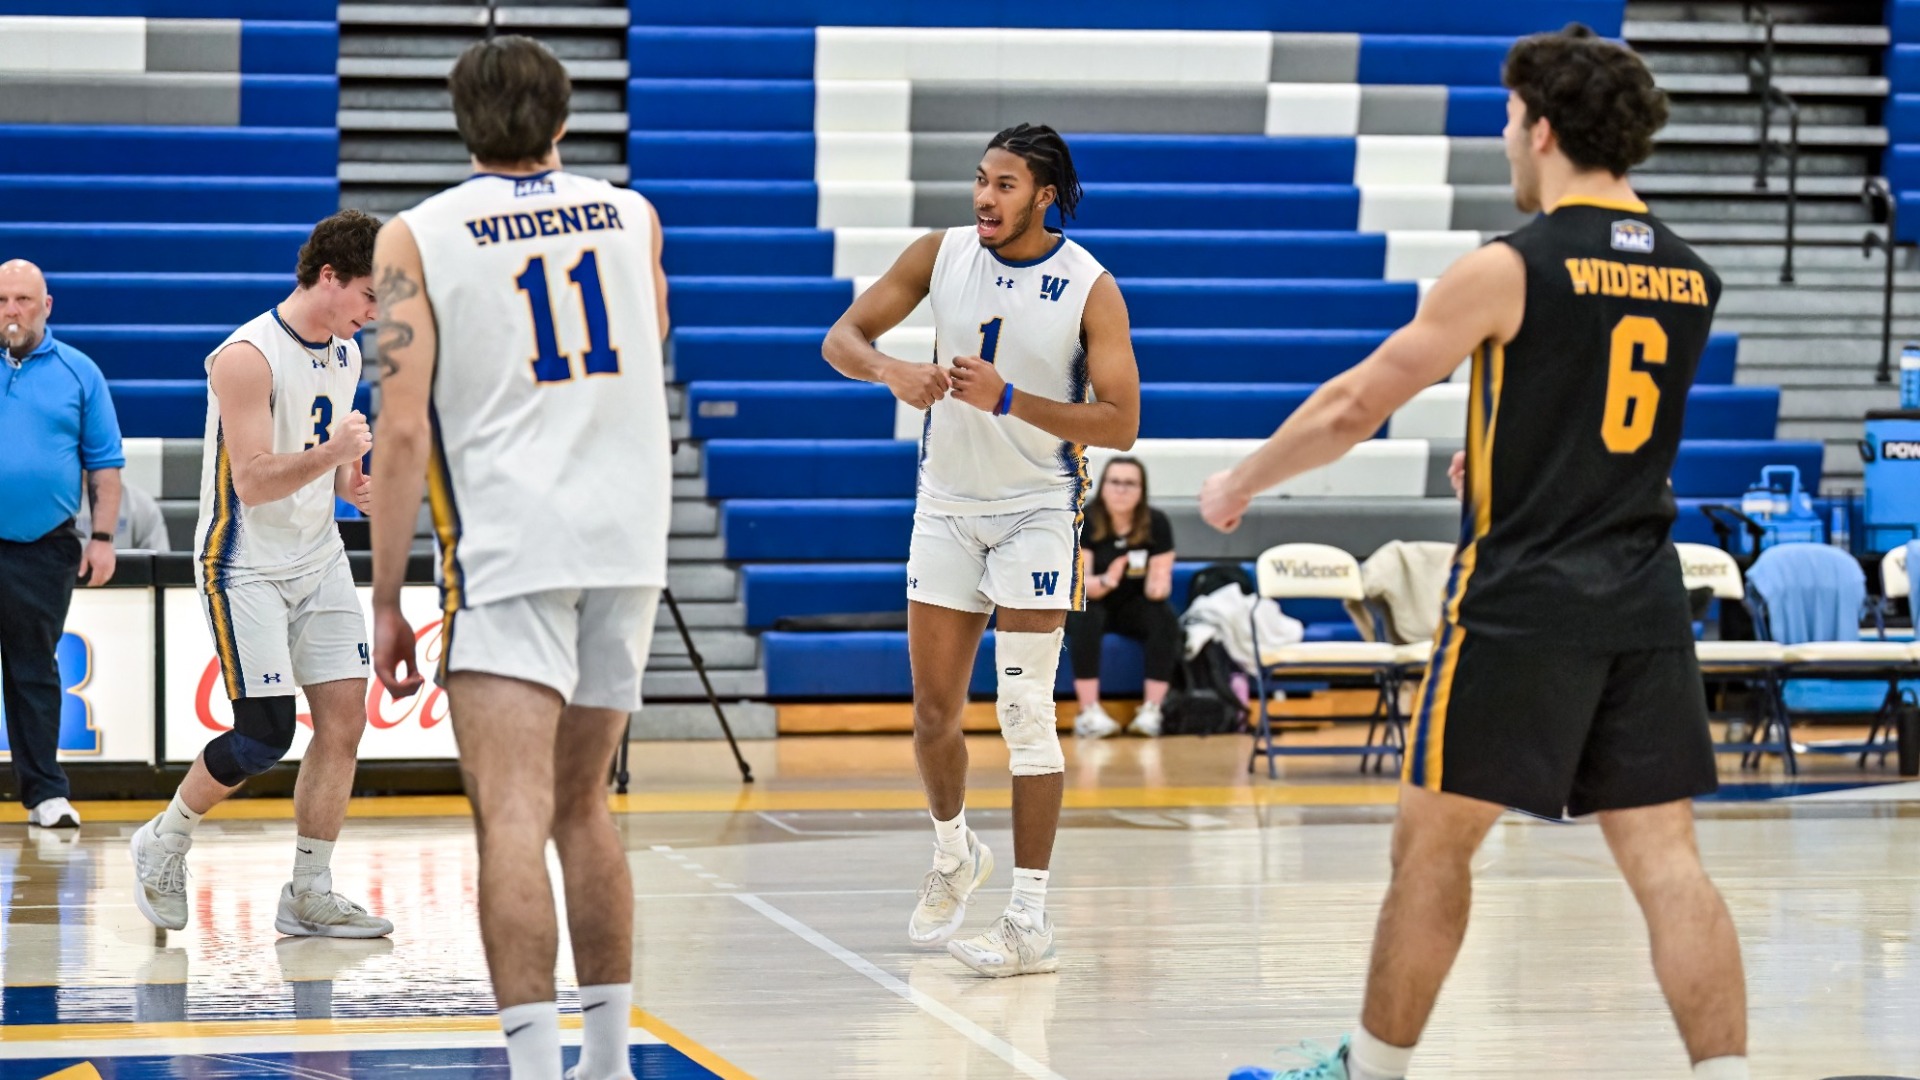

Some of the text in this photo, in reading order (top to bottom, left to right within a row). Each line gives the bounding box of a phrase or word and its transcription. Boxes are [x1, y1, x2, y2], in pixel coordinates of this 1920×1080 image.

[465, 202, 624, 246] WIDENER
[1614, 231, 1651, 249] MAC
[1039, 274, 1071, 302] W
[1565, 257, 1709, 306] WIDENER
[512, 247, 622, 388] 11
[979, 316, 1004, 365] 1
[1600, 314, 1668, 453] 6
[304, 394, 334, 452] 3
[1031, 571, 1060, 597] W
[1270, 558, 1351, 578] Widener
